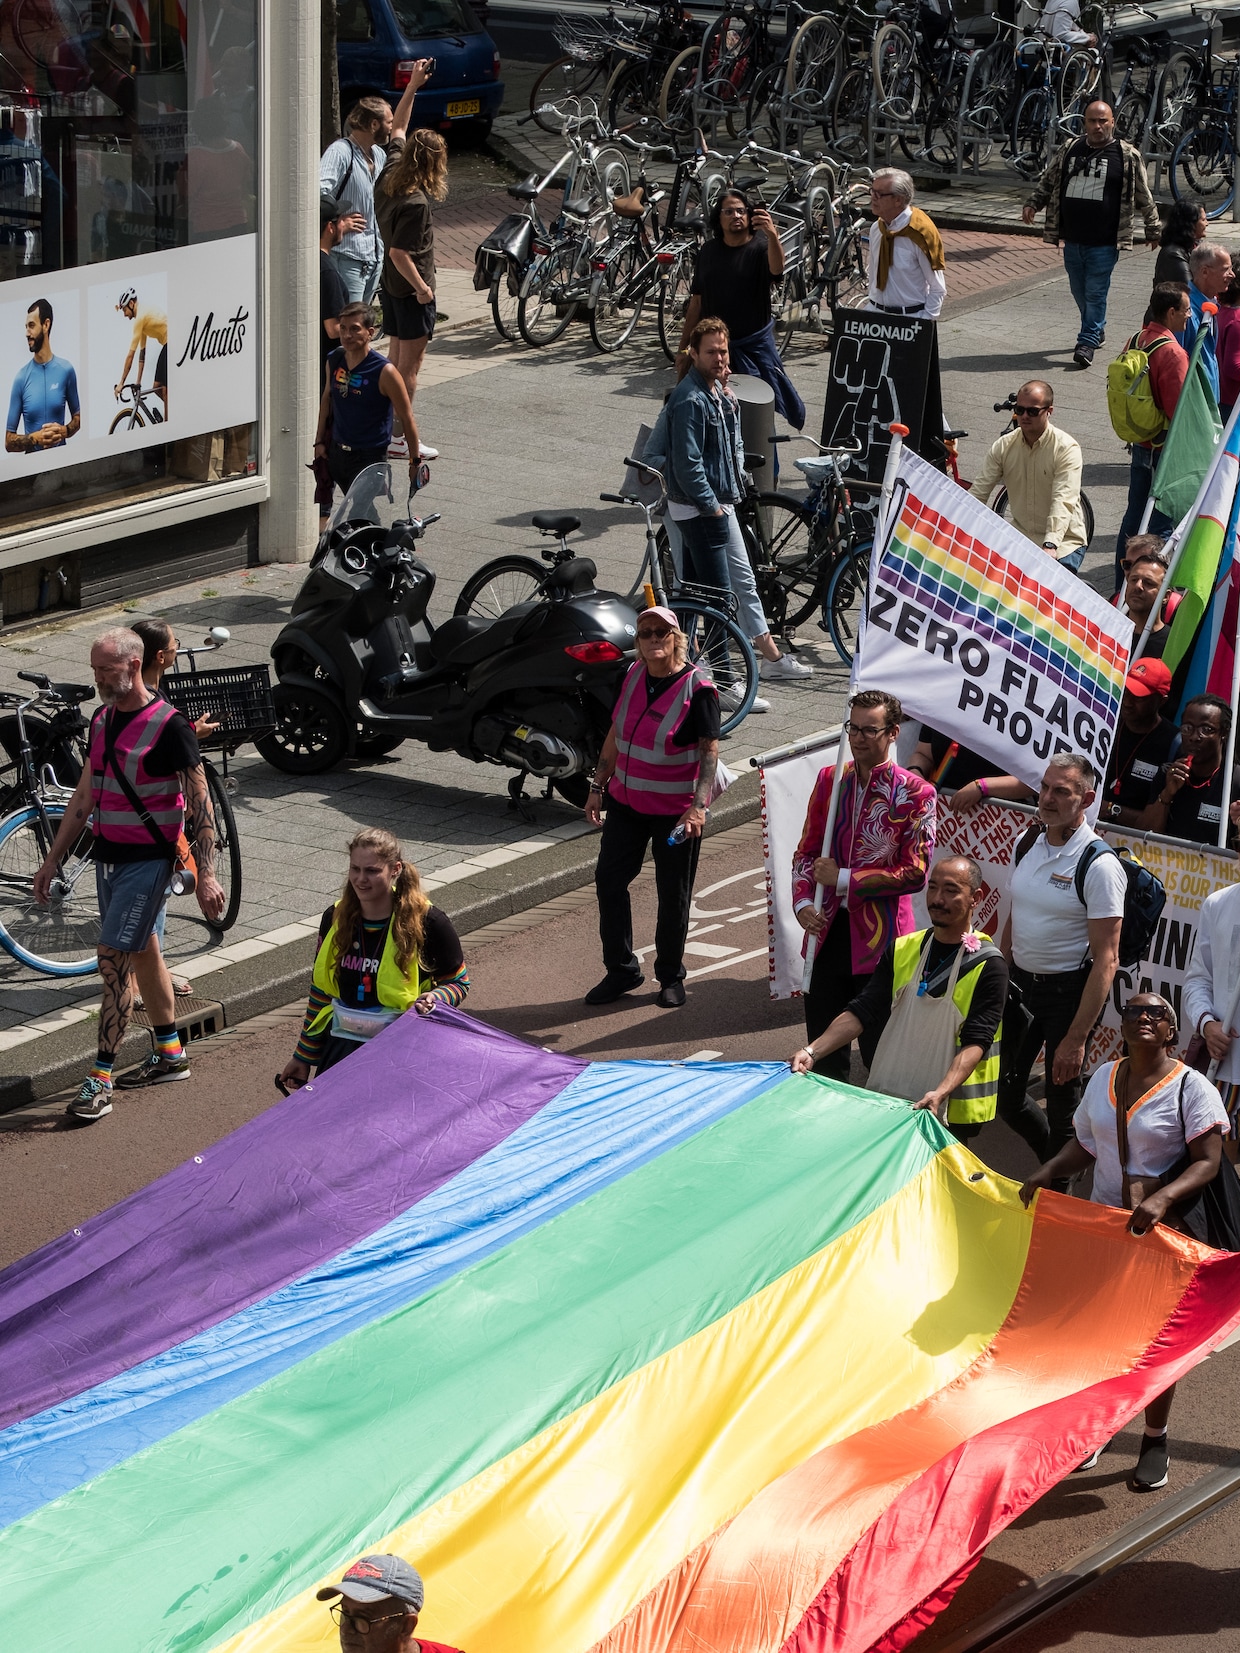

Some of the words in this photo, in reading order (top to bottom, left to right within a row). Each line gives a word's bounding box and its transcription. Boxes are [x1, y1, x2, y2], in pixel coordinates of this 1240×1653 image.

[175, 305, 250, 368] Maats
[869, 584, 990, 678] ZERO
[1000, 658, 1111, 770] FLAGS
[981, 822, 1012, 855] THIS
[1132, 842, 1163, 866] OUR
[1166, 849, 1207, 876] PRIDE
[119, 893, 149, 944] BROOKLYN
